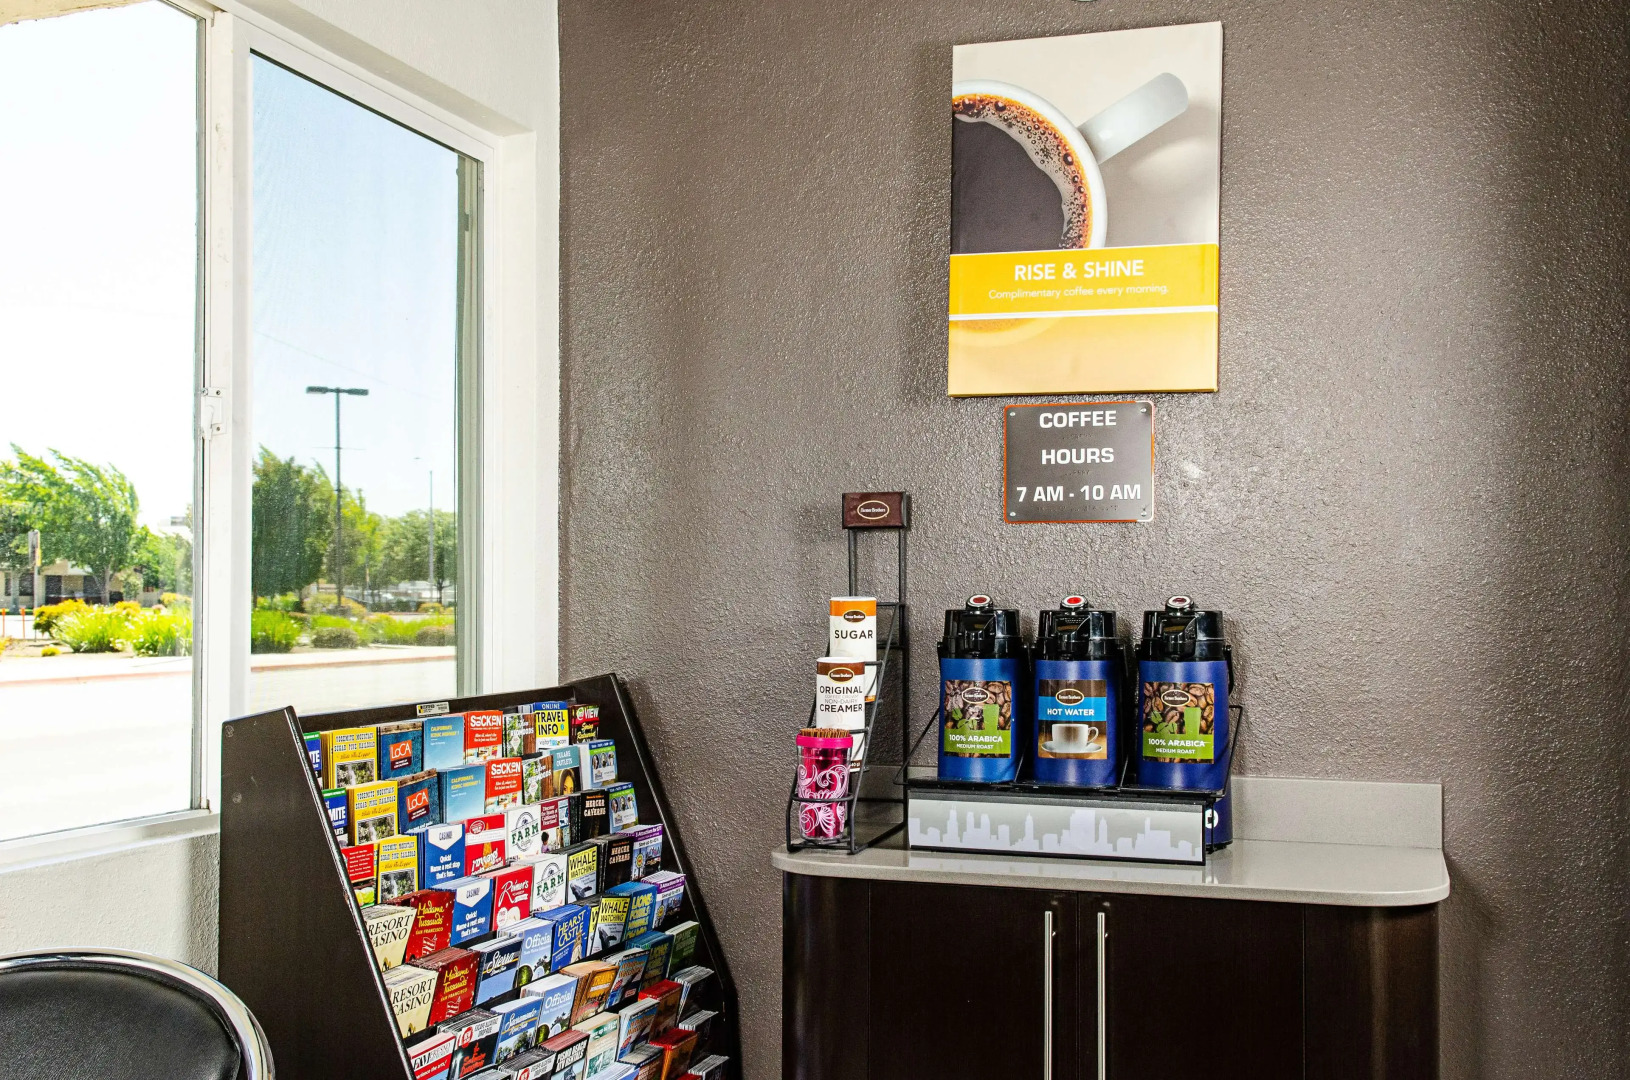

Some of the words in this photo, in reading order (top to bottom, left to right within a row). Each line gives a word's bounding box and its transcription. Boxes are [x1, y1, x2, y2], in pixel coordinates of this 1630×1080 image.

[1014, 263, 1056, 281] RISE
[1062, 262, 1077, 279] &
[1083, 259, 1145, 278] SHINE
[988, 288, 1061, 302] Complimentary
[1063, 285, 1094, 297] coffee
[1096, 285, 1123, 297] every
[1039, 410, 1117, 429] COFFEE
[1041, 447, 1115, 465] HOURS
[1016, 486, 1027, 502] 7
[1033, 485, 1064, 502] AM
[1080, 484, 1104, 501] 10
[1109, 483, 1141, 500] AM
[834, 629, 874, 640] SUGAR
[819, 685, 863, 694] ORIGINAL
[819, 703, 863, 712] CREAMER
[1047, 708, 1062, 716] HOT
[1065, 708, 1095, 716] WATER
[536, 712, 565, 723] TRAVEL
[538, 724, 558, 736] INFO
[967, 735, 1003, 743] ARABICA
[1148, 738, 1166, 746] 100%
[1167, 739, 1205, 748] ARABICA
[556, 758, 572, 767] OUTLETS
[586, 799, 605, 808] MERCER
[328, 806, 346, 820] MITE
[584, 808, 606, 817] CAVERNS
[512, 823, 539, 844] FARM
[611, 845, 630, 855] MERCER
[570, 850, 596, 870] WHALE
[609, 854, 630, 864] CAVERNS
[570, 863, 596, 878] WATCHING
[536, 872, 564, 896] FARM
[418, 900, 445, 915] Madame
[600, 901, 628, 914] WHALE
[417, 913, 444, 928] Tussauds
[478, 917, 486, 926] stop
[558, 910, 585, 937] HEARST
[600, 912, 624, 922] WATCHING
[369, 914, 412, 936] RESORT
[371, 928, 408, 948] ASINO
[558, 922, 584, 947] CASTLE
[486, 950, 515, 974] Sierra
[444, 966, 470, 983] Madame
[392, 978, 435, 1004] RESORT
[443, 976, 468, 994] Tussauds
[545, 988, 574, 1009] Official
[504, 1008, 537, 1031] Sacramento
